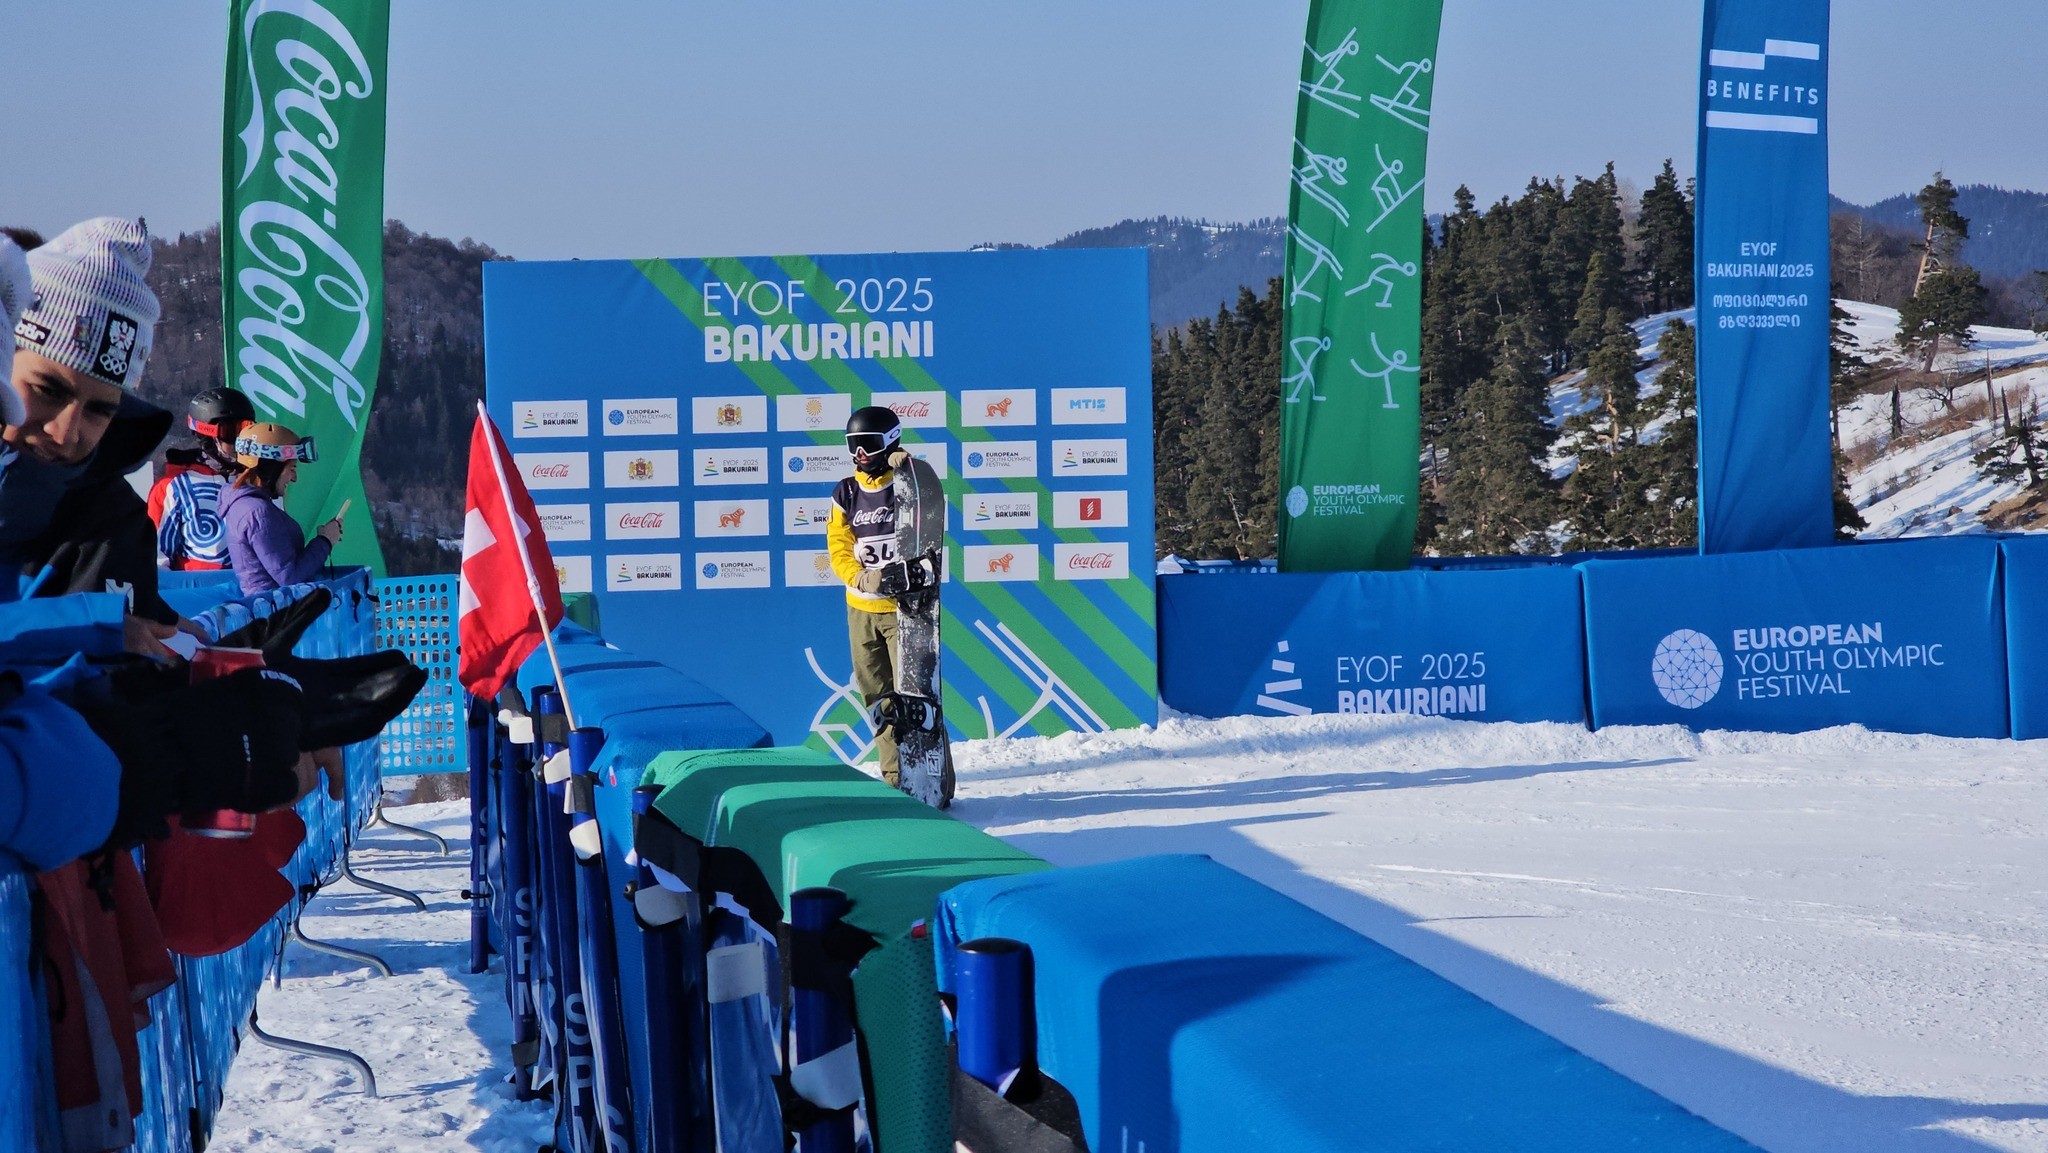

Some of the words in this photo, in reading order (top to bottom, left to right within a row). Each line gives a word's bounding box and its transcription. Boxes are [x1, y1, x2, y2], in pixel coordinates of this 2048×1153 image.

[1707, 79, 1819, 105] BENEFITS
[237, 0, 373, 432] Coca-Cola
[1741, 242, 1777, 256] EYOF
[1707, 263, 1778, 278] BAKURIANI
[1780, 264, 1814, 278] 2025
[703, 280, 805, 316] EYOF
[834, 277, 934, 313] 2025
[1713, 294, 1808, 308] ოფიციალური
[1719, 314, 1801, 329] მზღვეველი
[704, 320, 934, 363] BAKURIANI
[1070, 398, 1106, 410] MTIS
[532, 463, 570, 478] Coca-Cola
[1313, 484, 1380, 495] EUROPEAN
[1313, 495, 1354, 505] YOUTH
[1356, 495, 1405, 504] OLYMPIC
[1313, 505, 1364, 516] FESTIVAL
[619, 512, 666, 529] Coca-Cola
[1069, 552, 1115, 569] Coca-Cola
[1733, 622, 1883, 651] EUROPEAN
[1337, 655, 1403, 683] EYOF
[1421, 652, 1486, 680] 2025
[1735, 649, 1825, 675] YOUTH
[1833, 643, 1944, 671] OLYMPIC
[1738, 673, 1851, 700] FESTIVAL
[1338, 684, 1486, 715] BAKURIANI
